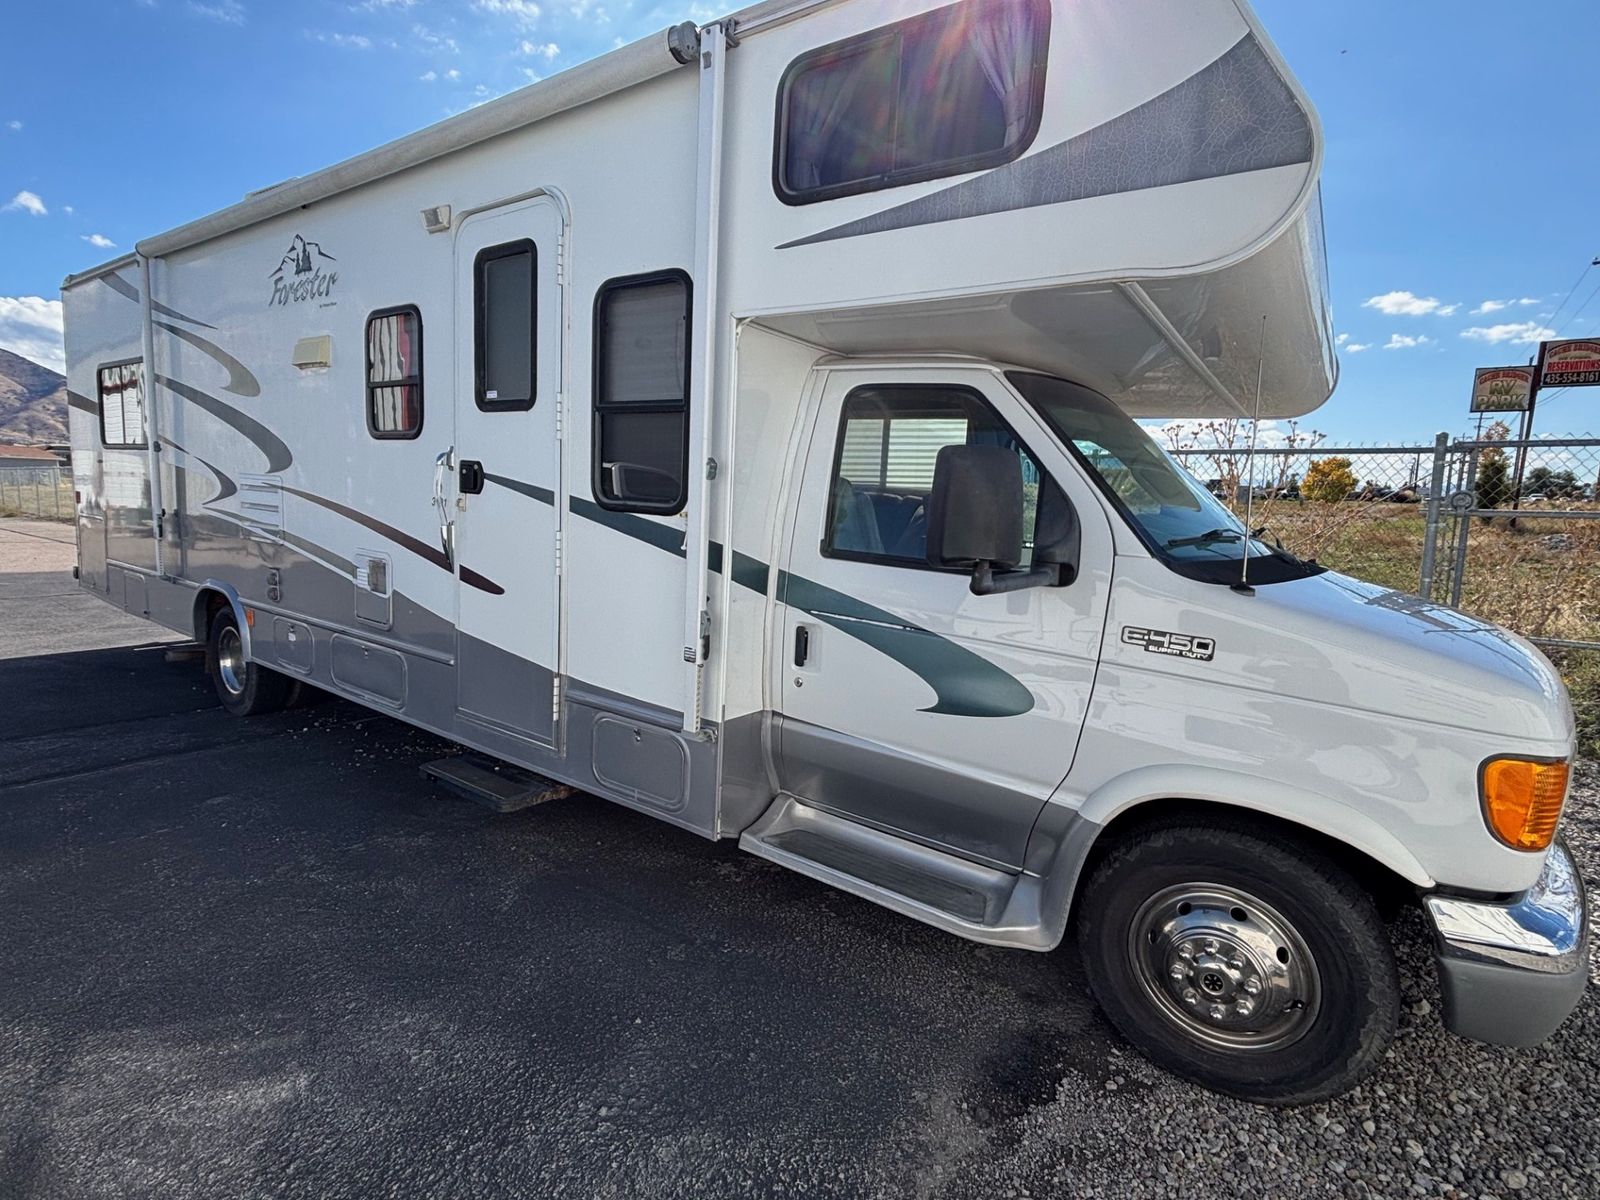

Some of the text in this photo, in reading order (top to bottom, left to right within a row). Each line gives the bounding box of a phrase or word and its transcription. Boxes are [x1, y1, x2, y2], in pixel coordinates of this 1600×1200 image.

[268, 266, 337, 306] Forester
[1547, 359, 1600, 372] RESERVATIONS
[1545, 371, 1600, 384] 435-554-8161
[1489, 379, 1517, 395] RV
[1475, 394, 1527, 410] PARK
[1148, 645, 1209, 660] SUPER DUTY
